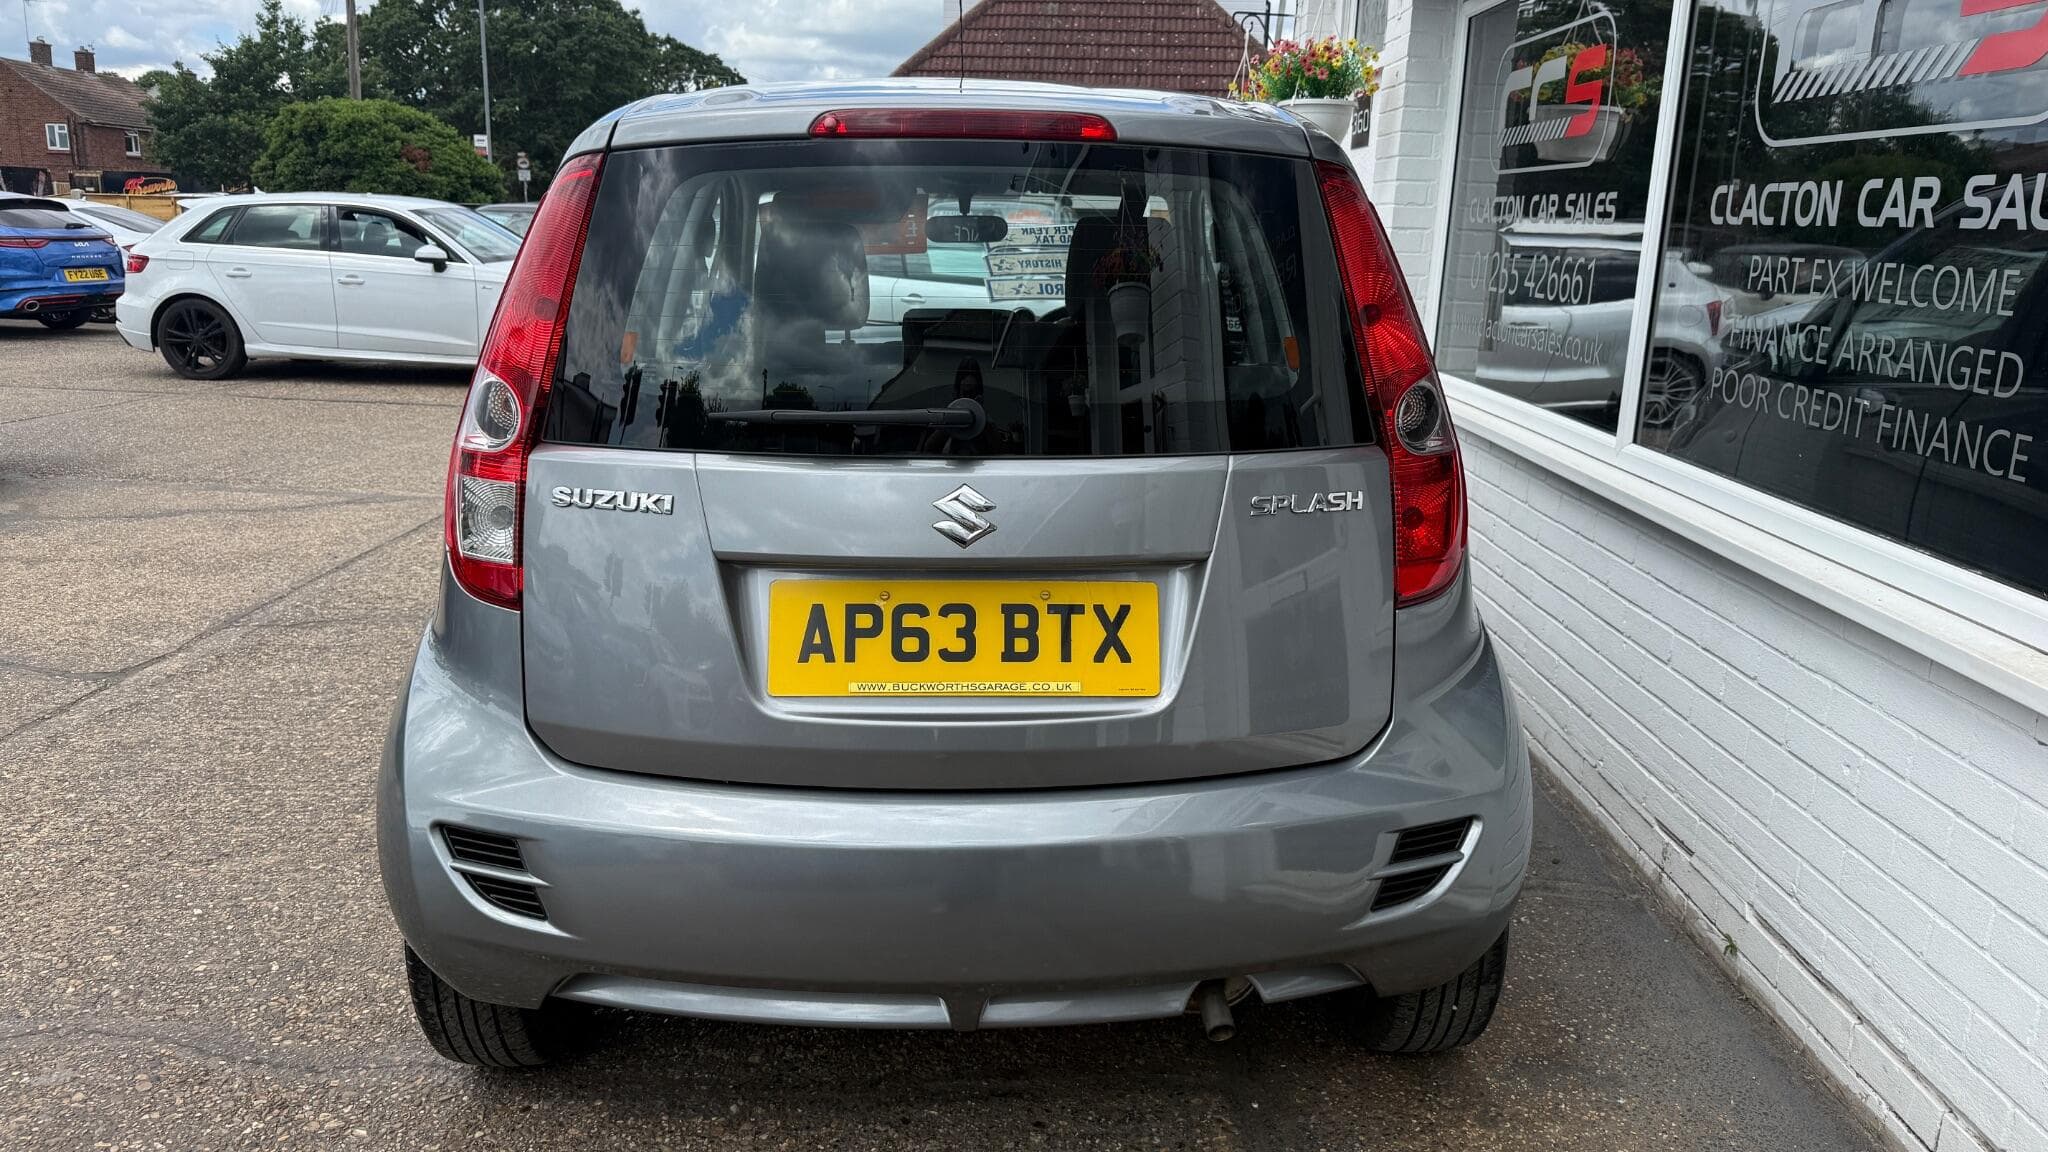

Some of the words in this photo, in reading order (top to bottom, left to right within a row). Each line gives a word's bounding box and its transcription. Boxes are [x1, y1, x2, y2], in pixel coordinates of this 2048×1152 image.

[1351, 109, 1369, 135] 360
[1469, 195, 1526, 226] CLACTON
[1529, 193, 1559, 224] CAR
[1565, 191, 1618, 225] SALES
[1710, 180, 1844, 227] CLACTON
[1857, 176, 1941, 229] CAR
[1470, 252, 1522, 296] 01255
[1524, 255, 1596, 305] 426661
[1747, 255, 1805, 295] PART
[1809, 258, 1845, 299] EX
[1850, 261, 2022, 317] WELCOME
[1728, 313, 1832, 365] FINANCE
[1835, 323, 2025, 399] ARRANGED
[1710, 366, 1772, 414] POOR
[1776, 382, 1866, 438] CREDIT
[1876, 403, 2034, 483] FINANCE
[551, 486, 674, 515] SUZUKI
[1250, 490, 1364, 516] SPLASH
[797, 603, 977, 664] AP63
[1000, 604, 1132, 664] BTX
